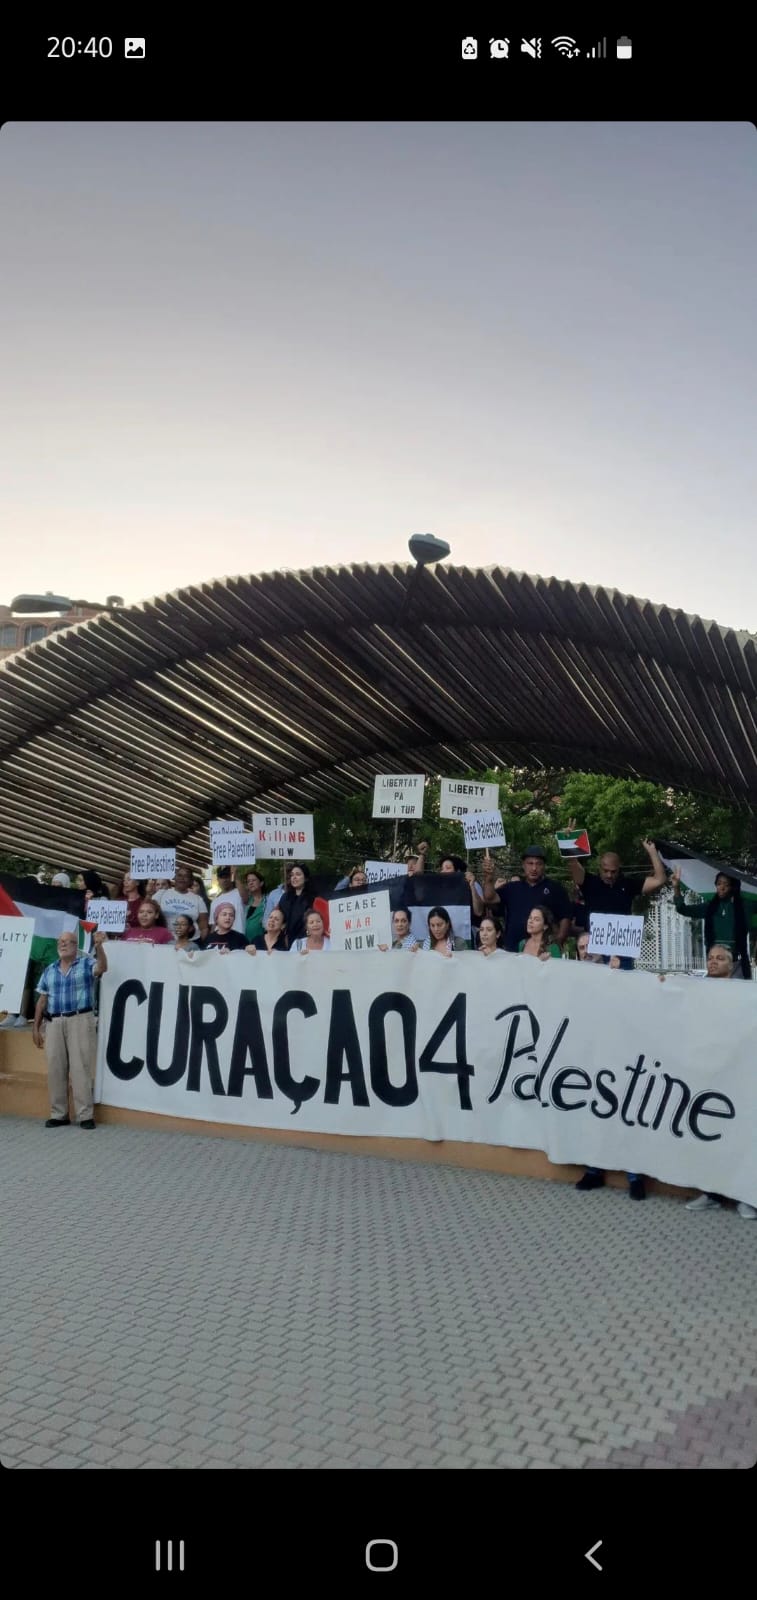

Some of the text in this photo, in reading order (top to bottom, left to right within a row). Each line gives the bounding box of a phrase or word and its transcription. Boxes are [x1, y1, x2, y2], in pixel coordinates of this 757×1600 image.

[383, 778, 418, 787] LIBERTAT
[448, 783, 485, 796] LIBERTY
[401, 805, 416, 814] TUR
[451, 805, 468, 816] FOR
[266, 817, 295, 827] STOP
[464, 817, 504, 841] Free Palestina
[213, 838, 255, 859] Free Palestina
[270, 847, 294, 857] NOW
[132, 854, 175, 873] Free Palestina
[338, 897, 377, 913] CEASE
[344, 916, 371, 930] WAR
[589, 921, 641, 947] Free Palestina
[344, 934, 375, 950] NOW
[487, 1004, 736, 1142] Palestine
